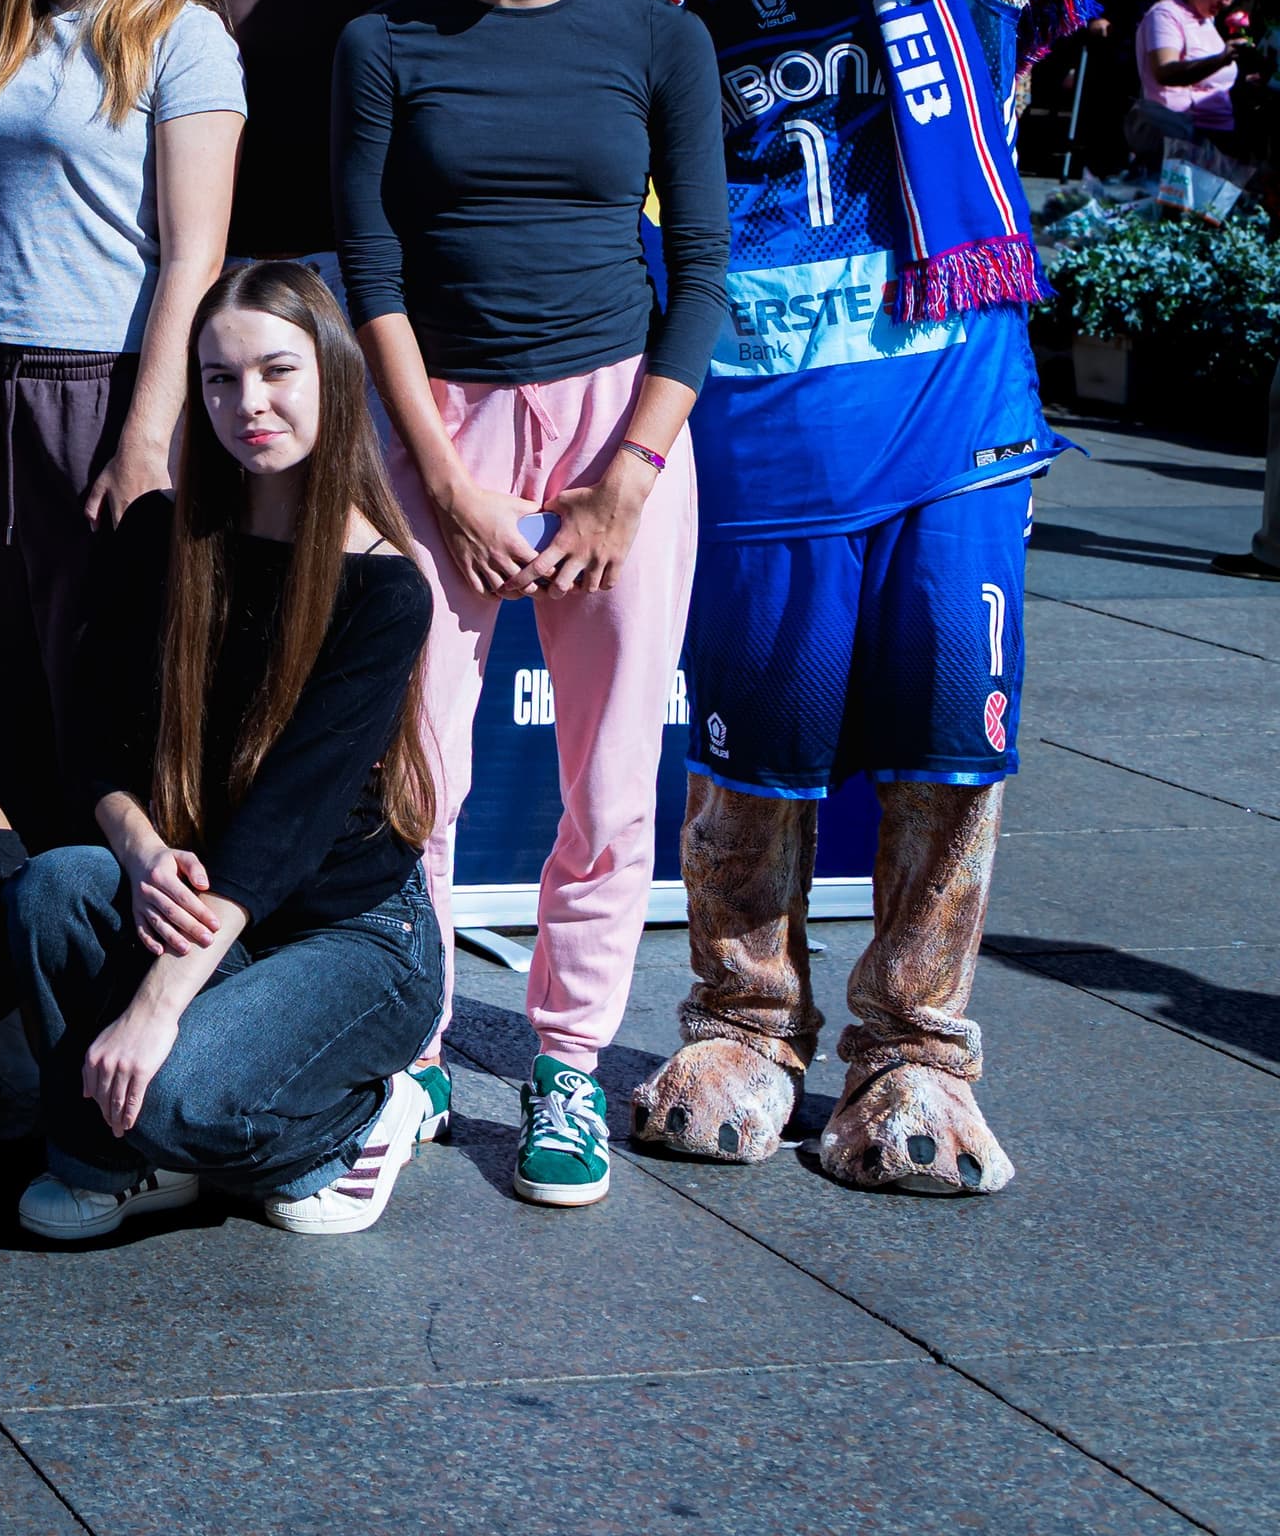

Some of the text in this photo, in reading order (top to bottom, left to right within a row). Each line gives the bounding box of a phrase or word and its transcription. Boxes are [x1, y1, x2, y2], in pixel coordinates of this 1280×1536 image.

[784, 119, 834, 227] 1
[729, 284, 875, 337] ERSTE
[740, 340, 792, 361] Bank
[982, 583, 1006, 677] 1
